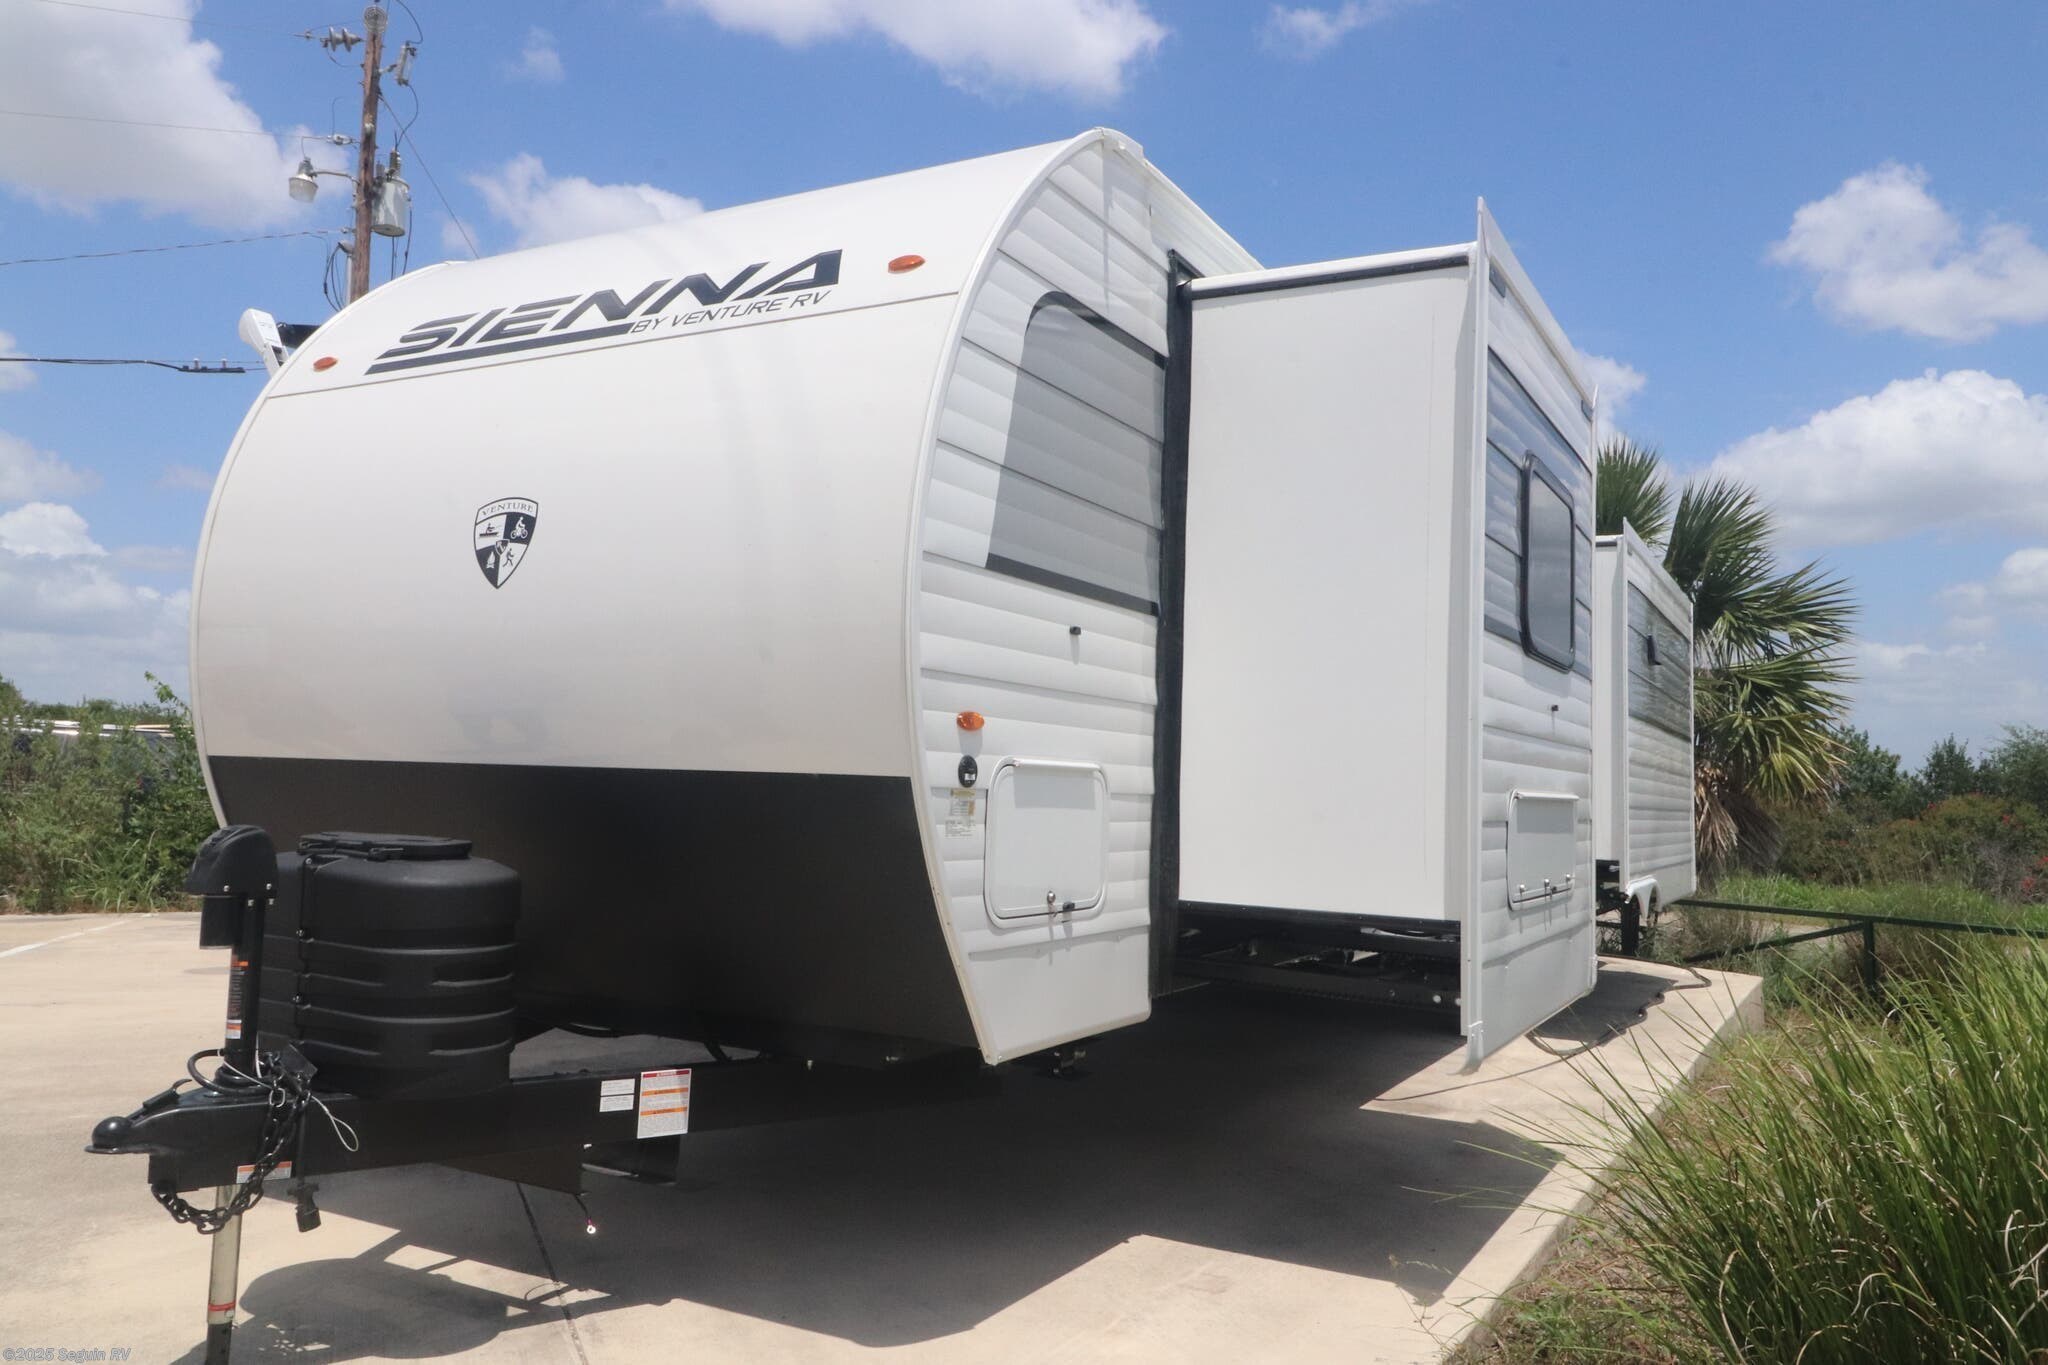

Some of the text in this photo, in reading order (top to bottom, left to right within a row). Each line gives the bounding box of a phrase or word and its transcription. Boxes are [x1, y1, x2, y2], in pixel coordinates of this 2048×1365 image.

[376, 249, 842, 359] SIENNA
[630, 290, 832, 334] BY VENTURE RV
[482, 502, 533, 515] VENTURE
